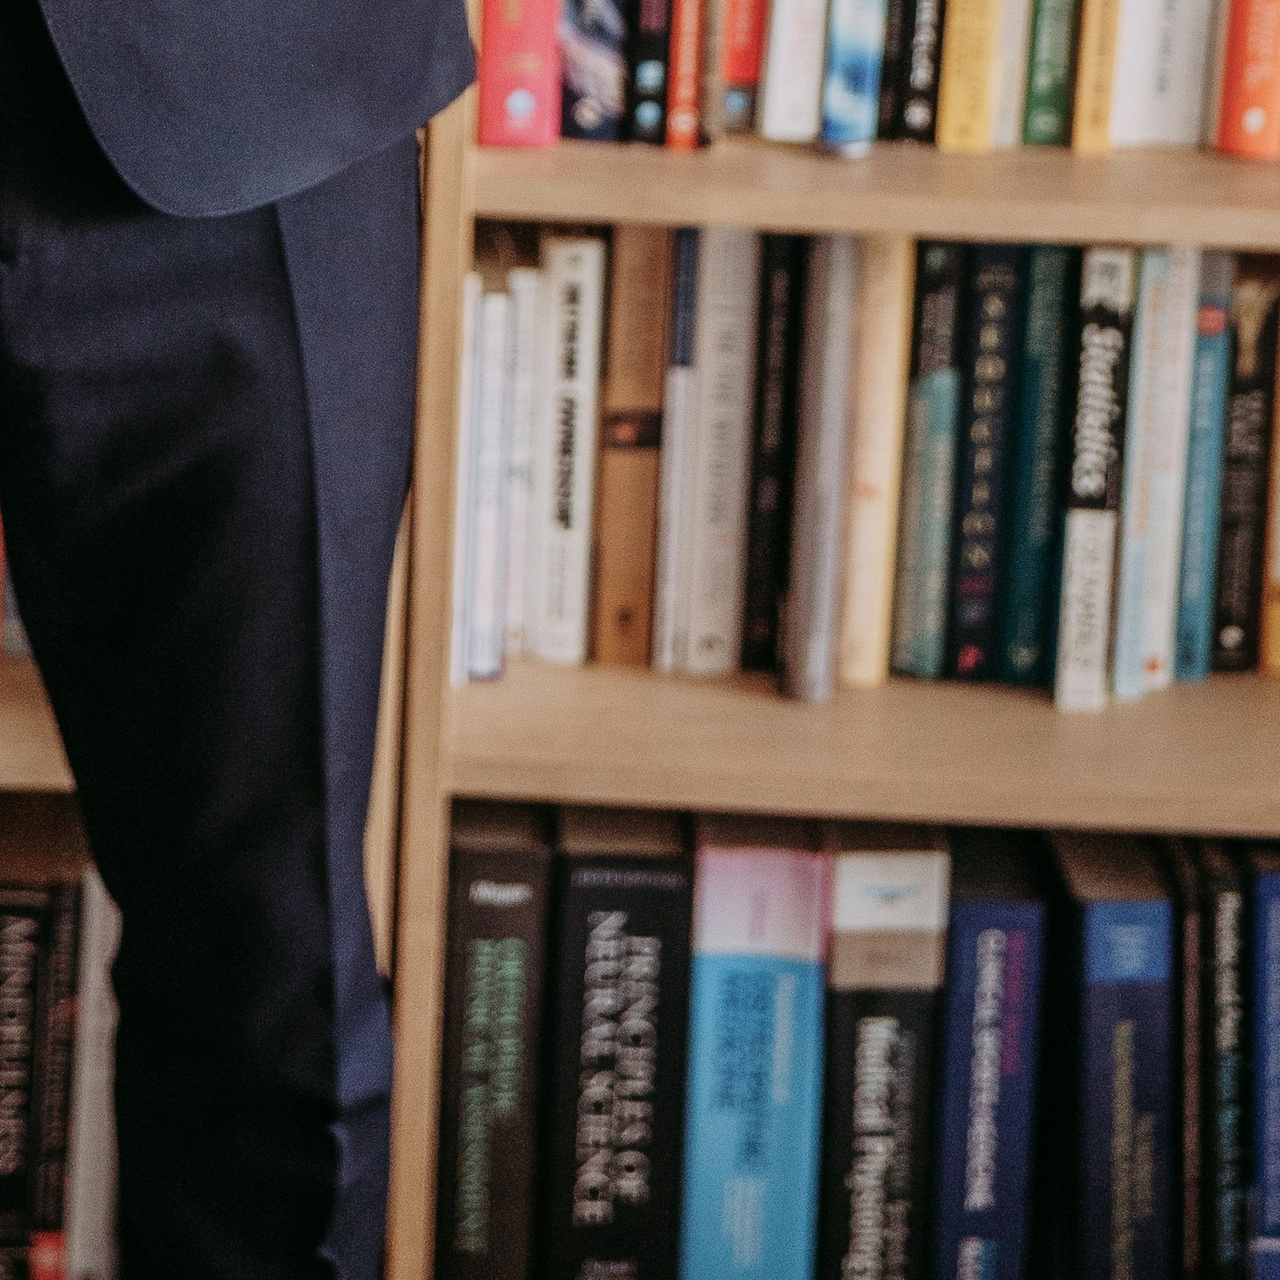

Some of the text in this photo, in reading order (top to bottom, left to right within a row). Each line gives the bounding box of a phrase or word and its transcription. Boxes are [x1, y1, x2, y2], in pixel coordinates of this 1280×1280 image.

[1071, 323, 1124, 498] Statistics
[571, 911, 630, 1227] NEURAL SCIENCE
[610, 936, 663, 1207] PRINCIPLES OF
[853, 1017, 901, 1132] Medical
